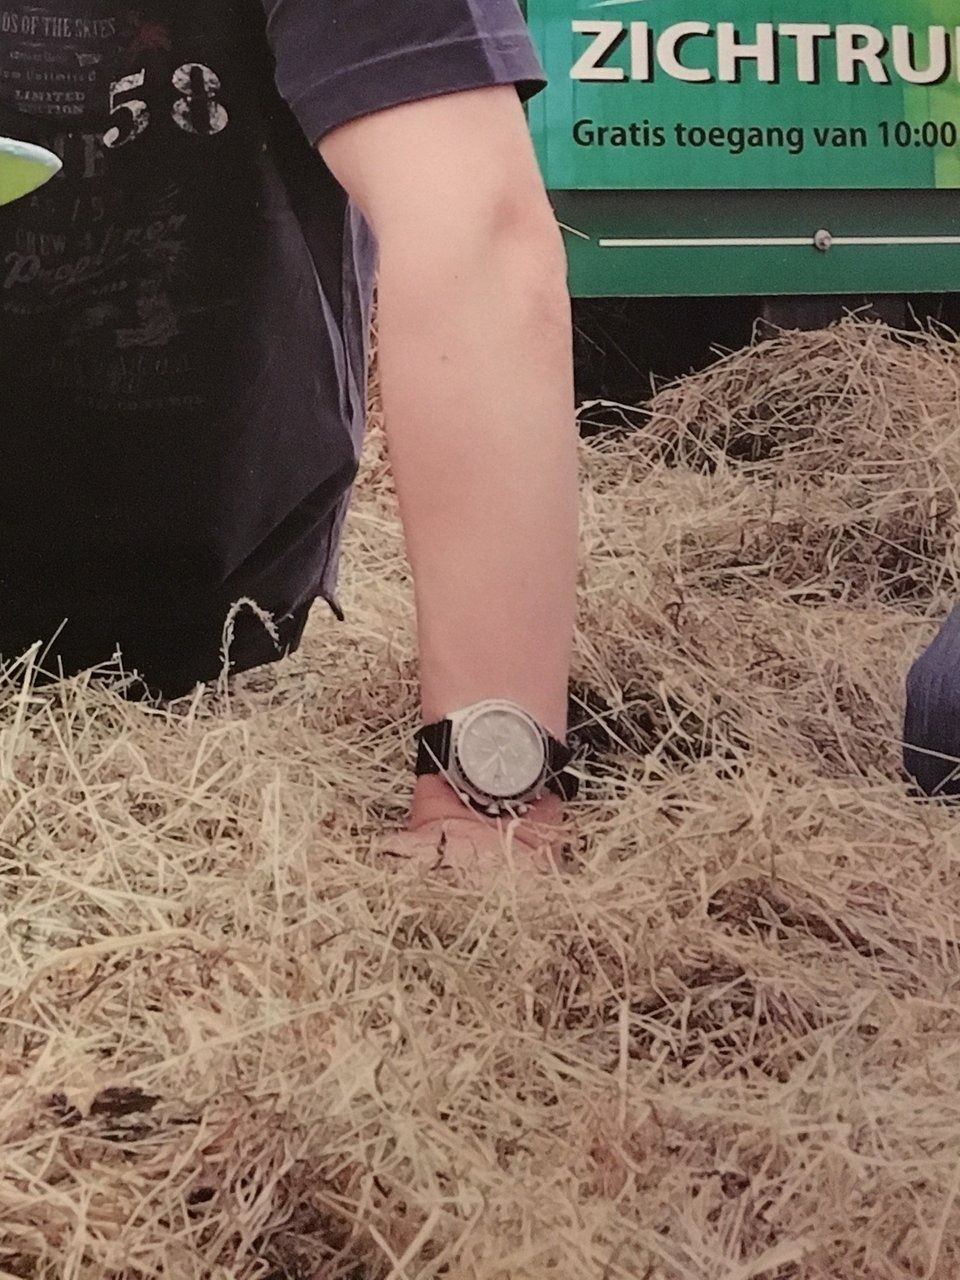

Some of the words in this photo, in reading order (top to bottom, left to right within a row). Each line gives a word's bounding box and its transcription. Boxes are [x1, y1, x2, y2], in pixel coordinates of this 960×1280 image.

[21, 16, 40, 36] OF
[41, 16, 72, 39] THE
[570, 20, 960, 85] ZICHTRU
[14, 89, 86, 104] LIMITED
[572, 119, 666, 148] Gratis
[675, 123, 804, 155] toegang
[813, 126, 868, 148] van
[878, 121, 957, 148] 10:00
